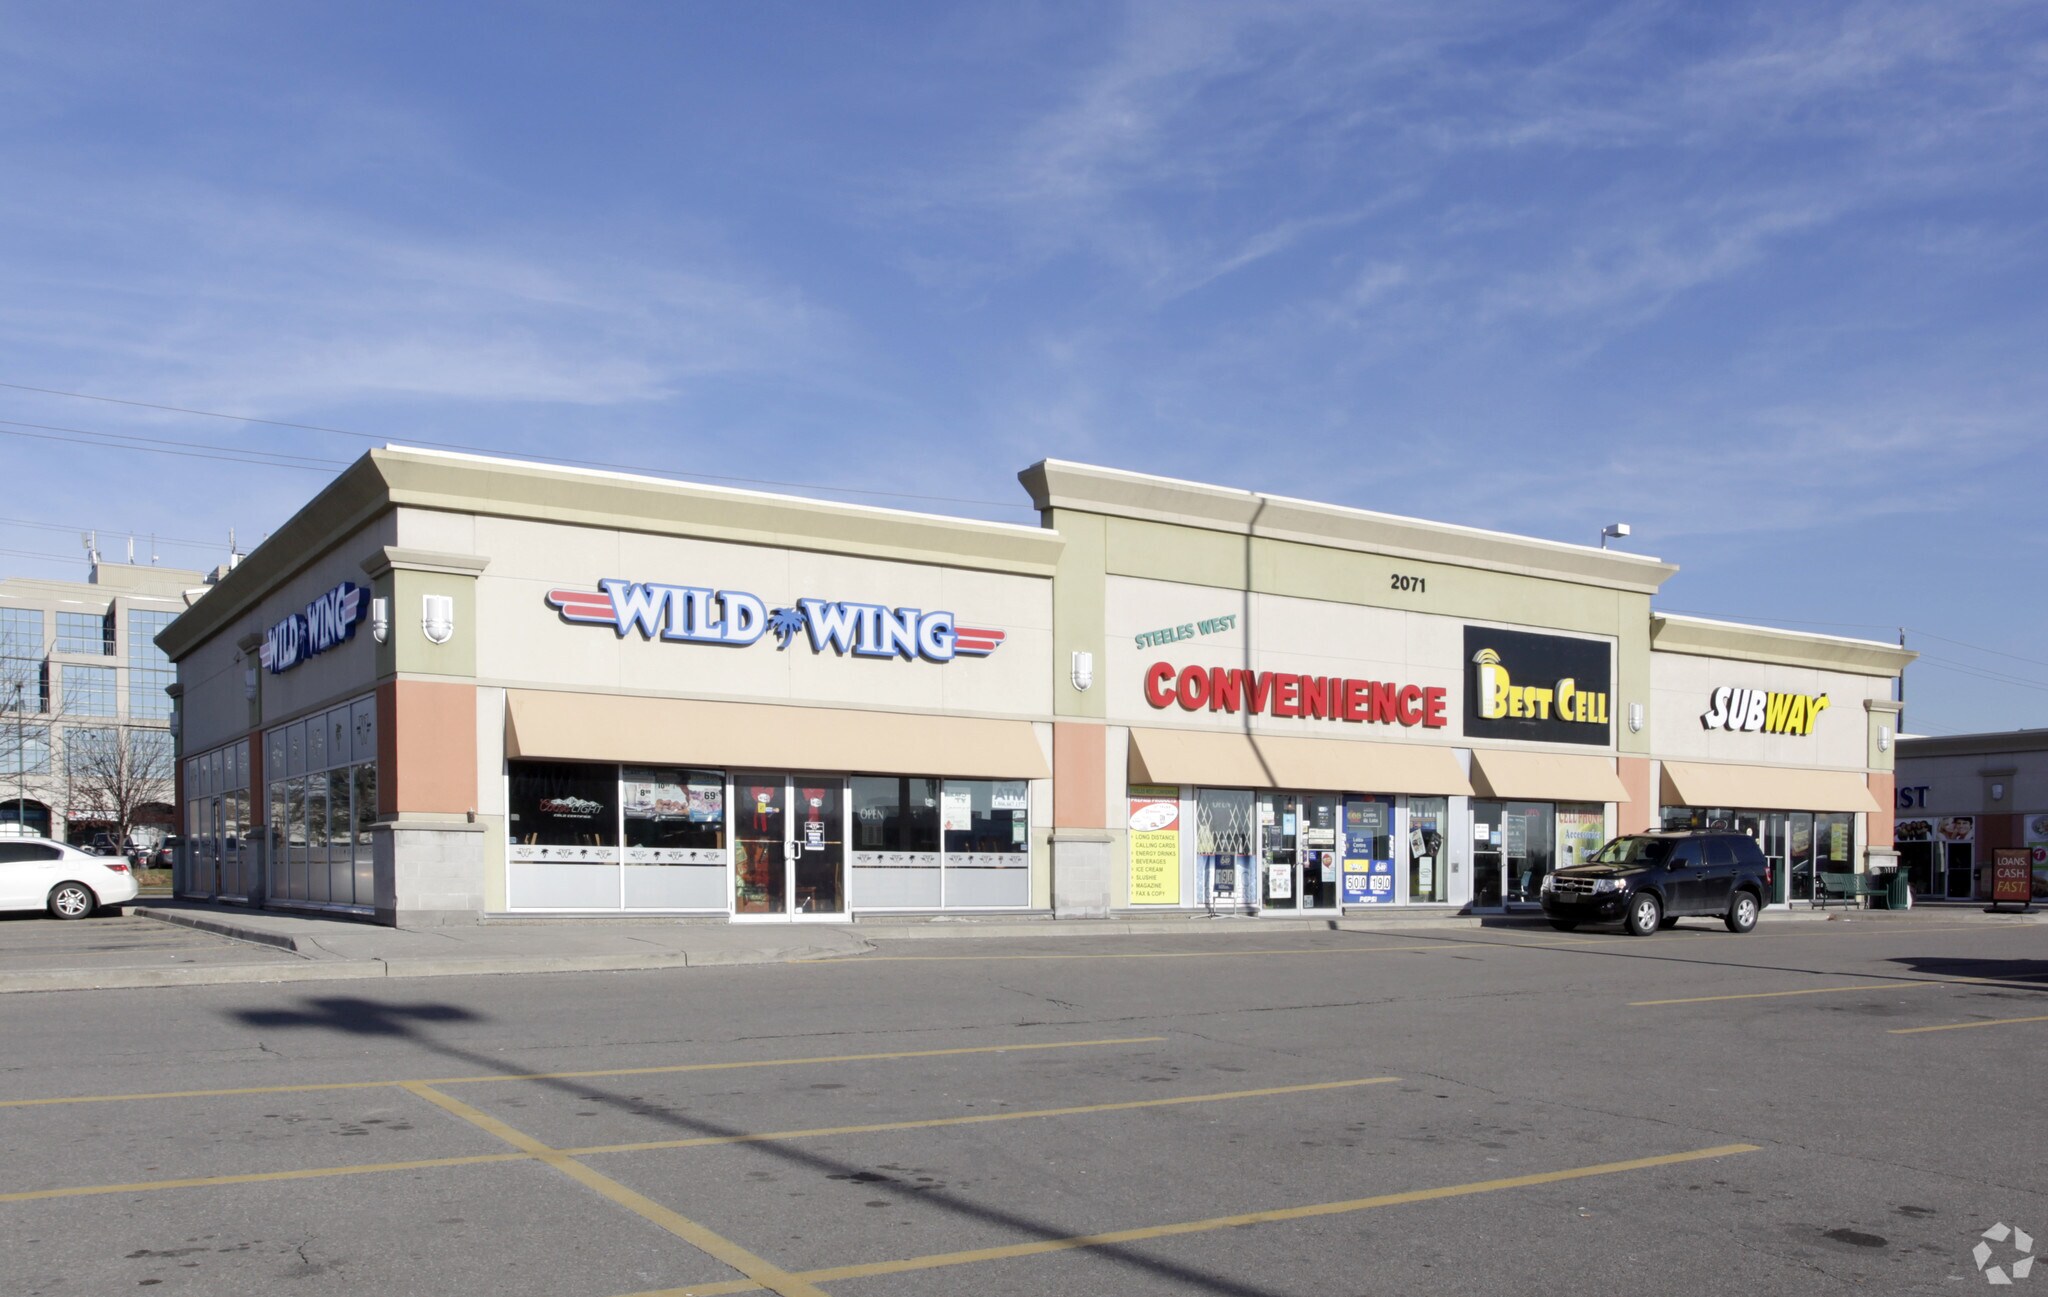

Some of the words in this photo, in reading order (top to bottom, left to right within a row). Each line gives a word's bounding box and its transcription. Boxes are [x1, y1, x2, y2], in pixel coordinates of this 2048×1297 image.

[1391, 574, 1426, 593] 2071
[267, 613, 300, 673] WILD
[305, 582, 347, 656] WING
[600, 578, 767, 645] WILD
[798, 598, 956, 661] WING
[1135, 623, 1195, 650] STEELES
[1199, 614, 1237, 636] WEST
[1144, 661, 1447, 728] CONVENIENCE
[1700, 686, 1832, 737] SUBWAY
[995, 787, 1026, 801] ATM
[860, 808, 884, 820] OPEN
[1559, 807, 1578, 824] CELL
[1997, 856, 2027, 866] LOANS.
[1996, 868, 2027, 879] CASH.
[1996, 881, 2027, 893] FAST.
